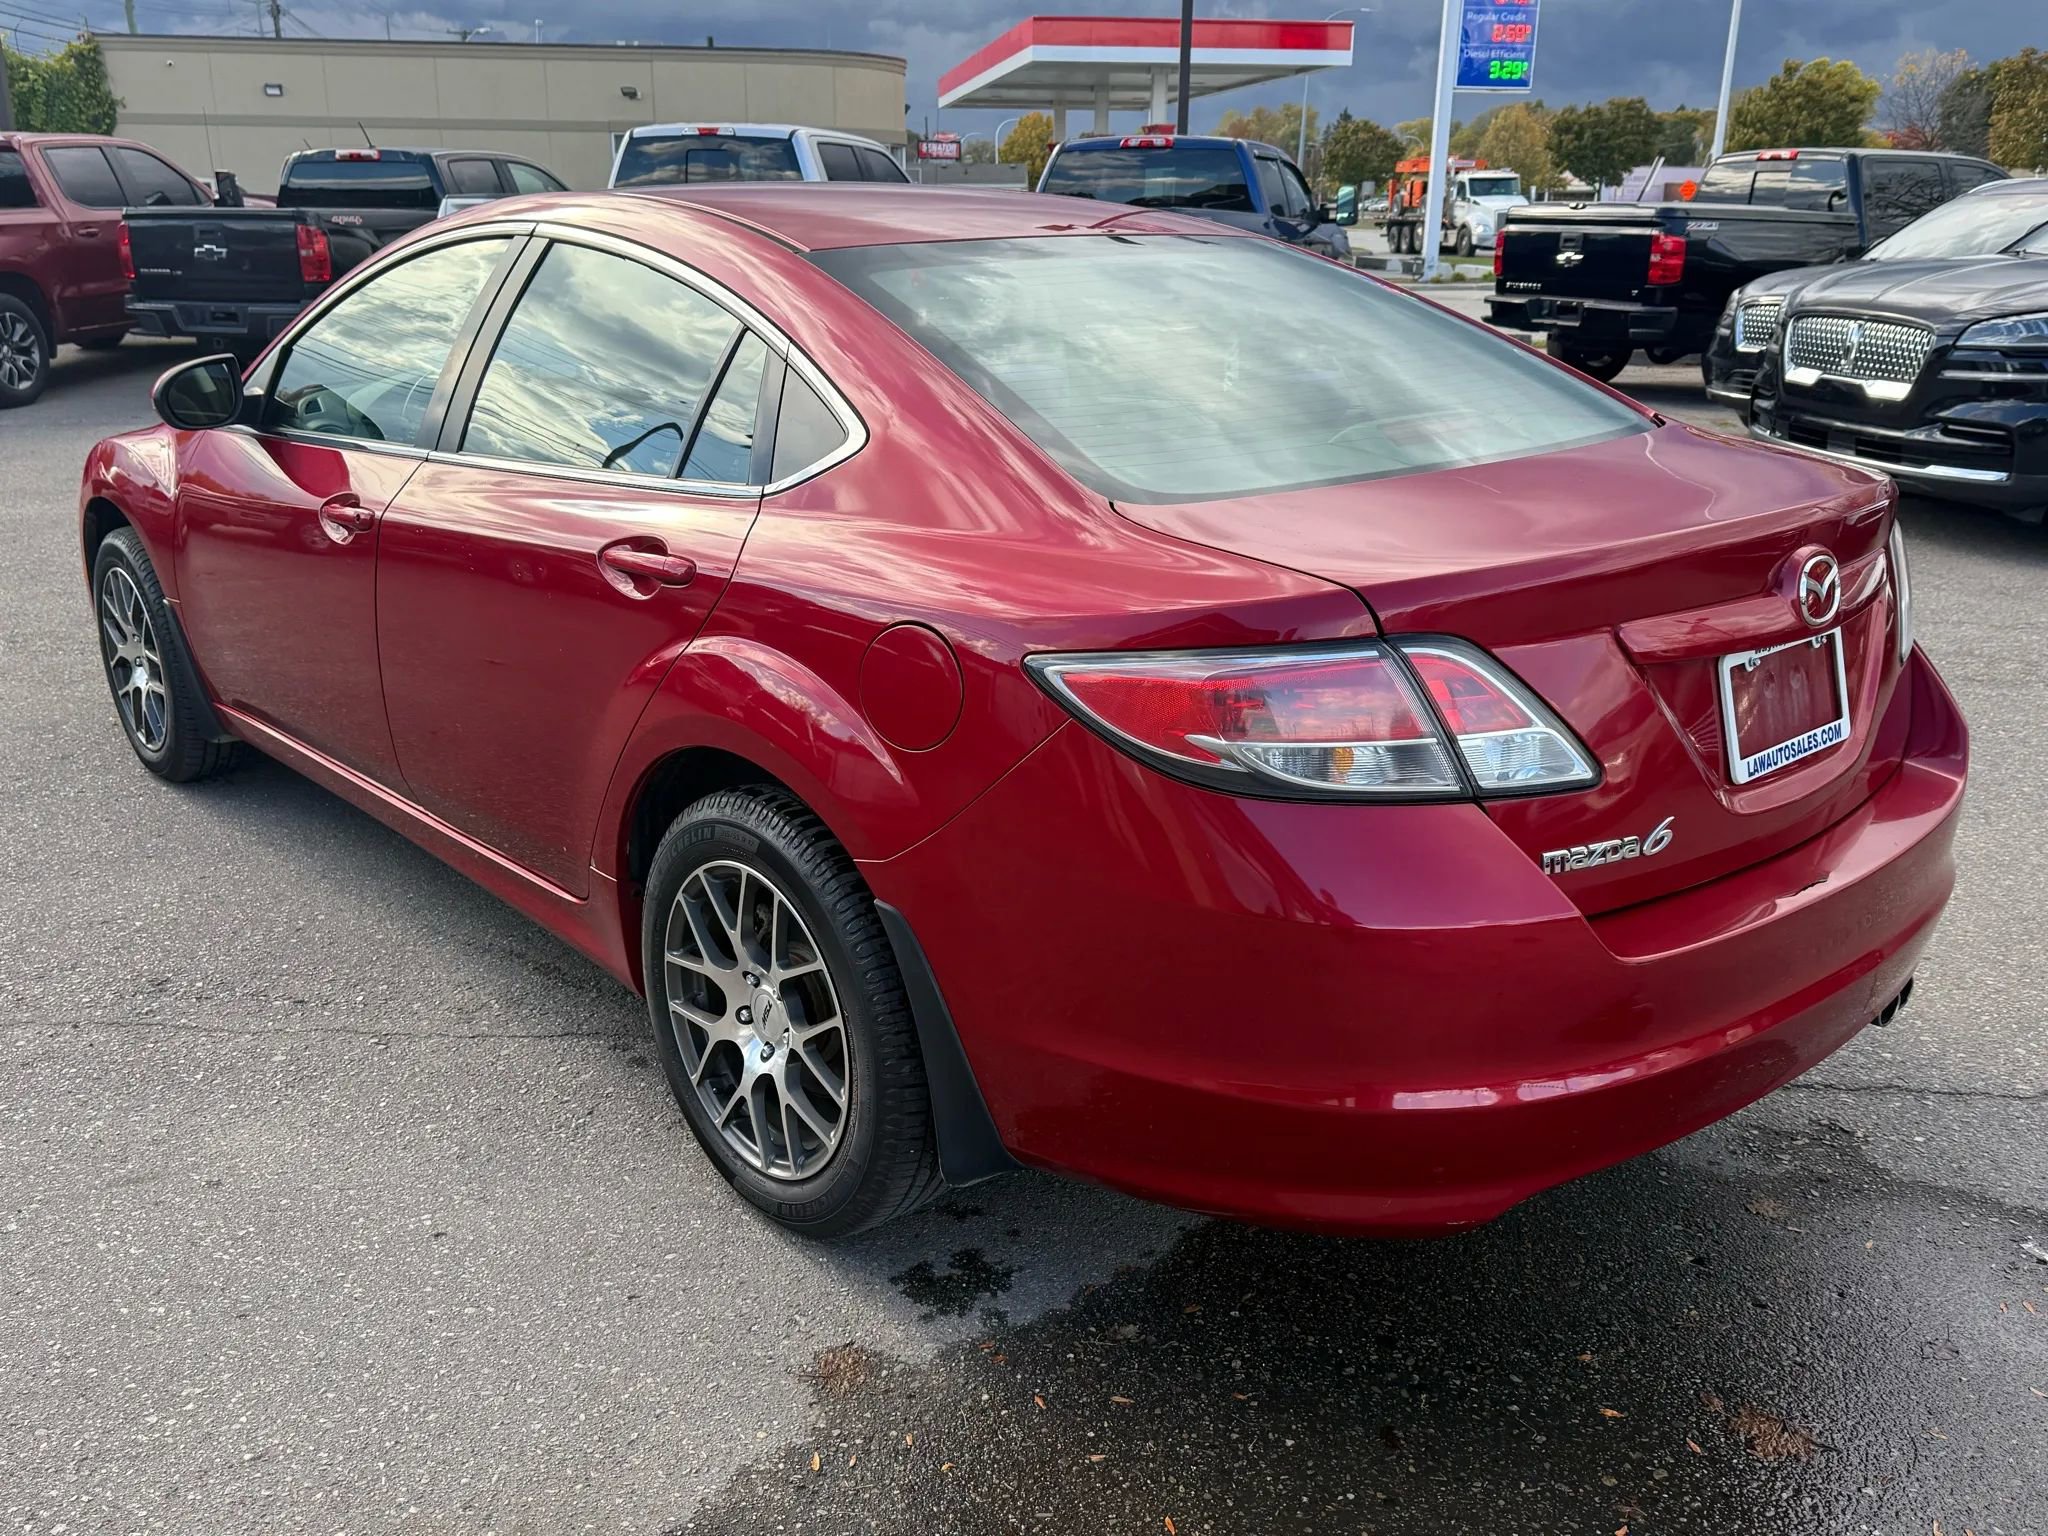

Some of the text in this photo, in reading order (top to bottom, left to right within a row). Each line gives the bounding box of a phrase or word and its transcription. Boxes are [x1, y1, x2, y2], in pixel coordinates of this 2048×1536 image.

[1467, 11, 1527, 23] Regular Credit
[1463, 49, 1526, 58] Diesel Efficient
[1746, 723, 1843, 778] LAWAUTOSALES.COM
